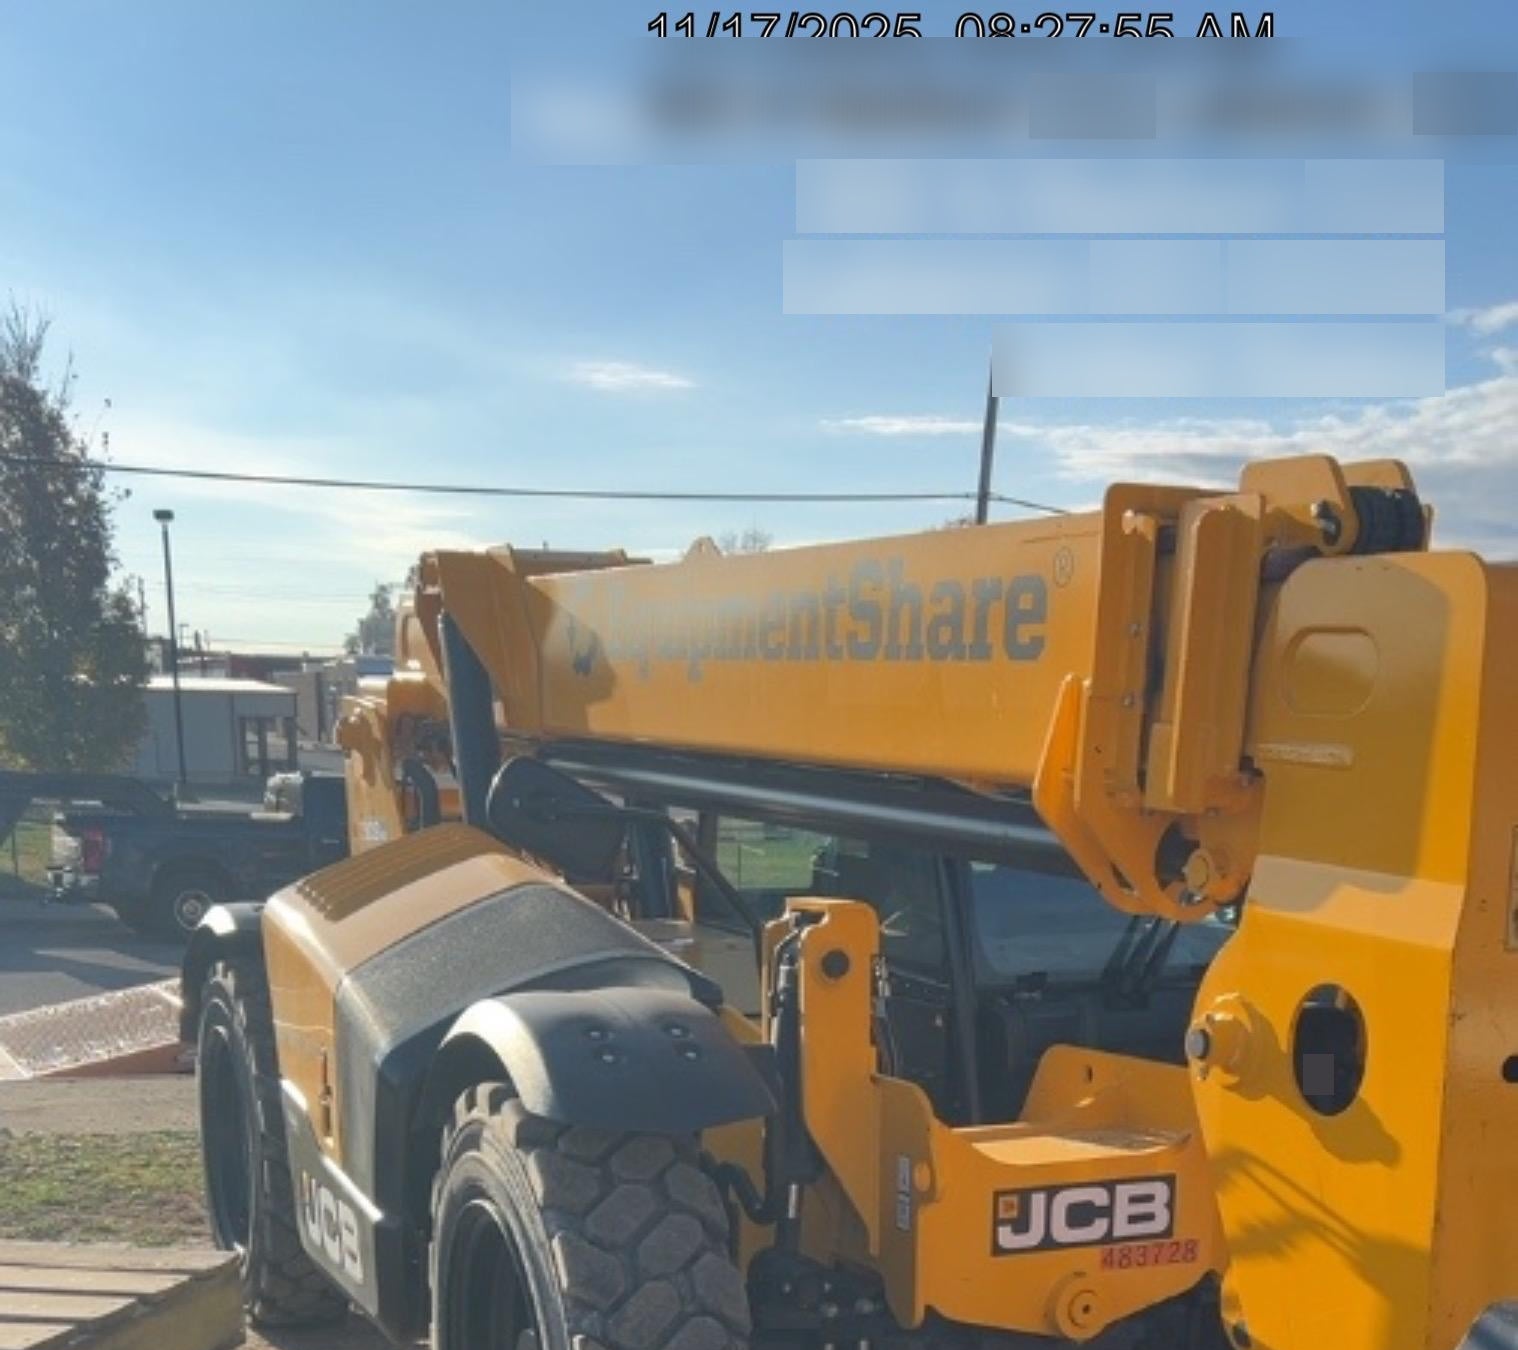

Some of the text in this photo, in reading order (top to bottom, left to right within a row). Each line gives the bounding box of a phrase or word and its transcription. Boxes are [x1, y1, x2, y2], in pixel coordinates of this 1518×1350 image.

[303, 1176, 364, 1285] JCB
[997, 1181, 1171, 1249] JCB
[1101, 1239, 1199, 1270] 483728
